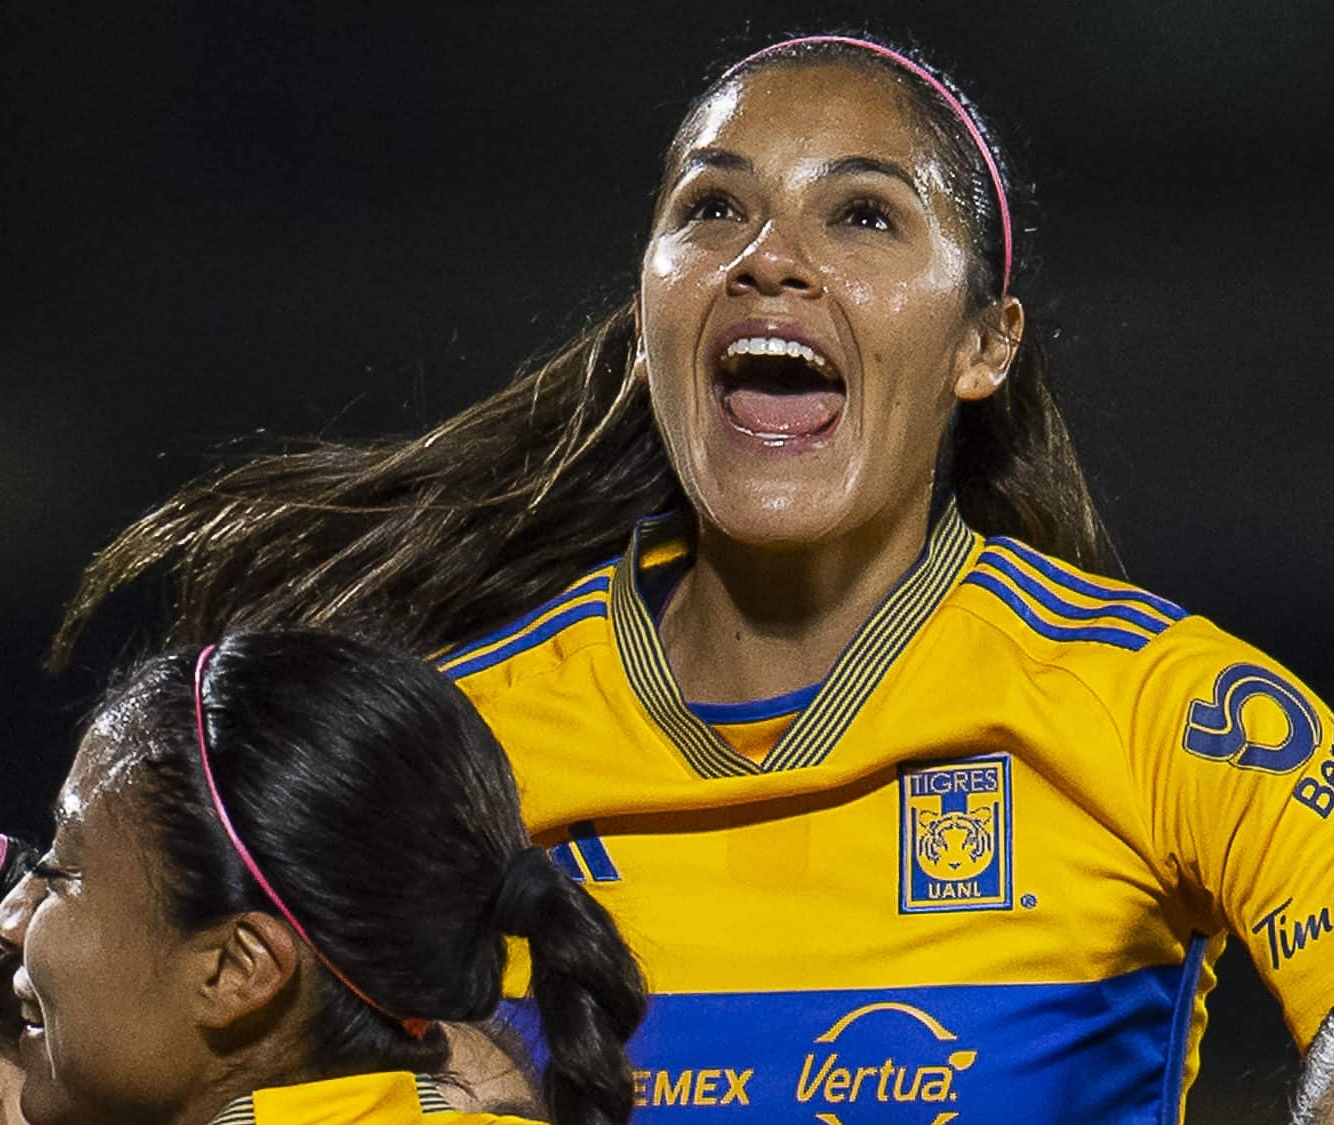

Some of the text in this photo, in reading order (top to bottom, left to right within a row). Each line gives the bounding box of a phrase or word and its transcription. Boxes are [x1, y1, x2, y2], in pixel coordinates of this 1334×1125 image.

[911, 768, 998, 795] TIGRES
[927, 881, 981, 899] UANL
[1252, 896, 1333, 970] Tim
[630, 1068, 754, 1107] EMEX
